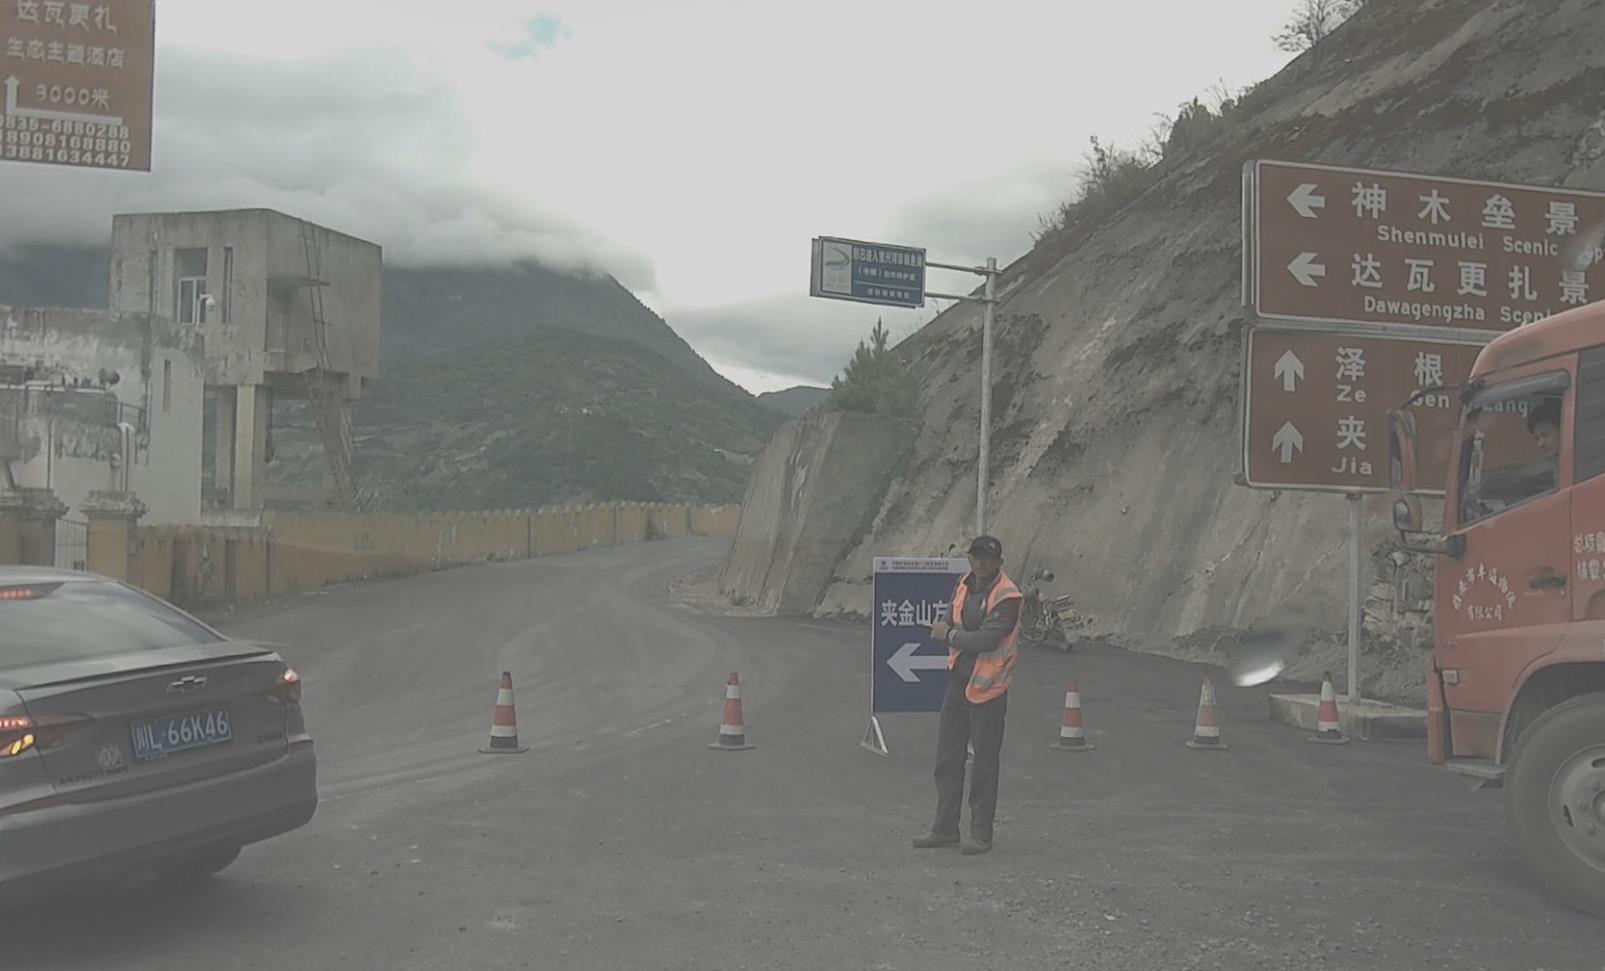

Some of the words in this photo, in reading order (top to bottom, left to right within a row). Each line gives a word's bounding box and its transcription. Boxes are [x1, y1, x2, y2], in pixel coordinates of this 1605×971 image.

[17, 0, 117, 35] 达瓦更扎
[6, 37, 125, 69] 生态主题酒店
[36, 84, 109, 110] 3000米
[1351, 182, 1579, 236] 神木垒景
[1377, 225, 1484, 249] Shenmulei
[1503, 236, 1558, 256] Scenic
[1351, 253, 1589, 305] 达瓦更扎景
[1364, 296, 1485, 322] Dawagengzha
[1500, 306, 1551, 323] Sceni
[1337, 385, 1367, 403] Ze
[1411, 390, 1449, 408] Gen
[1484, 400, 1528, 417] ang
[1336, 416, 1367, 450] 夹
[1331, 457, 1373, 475] Jia
